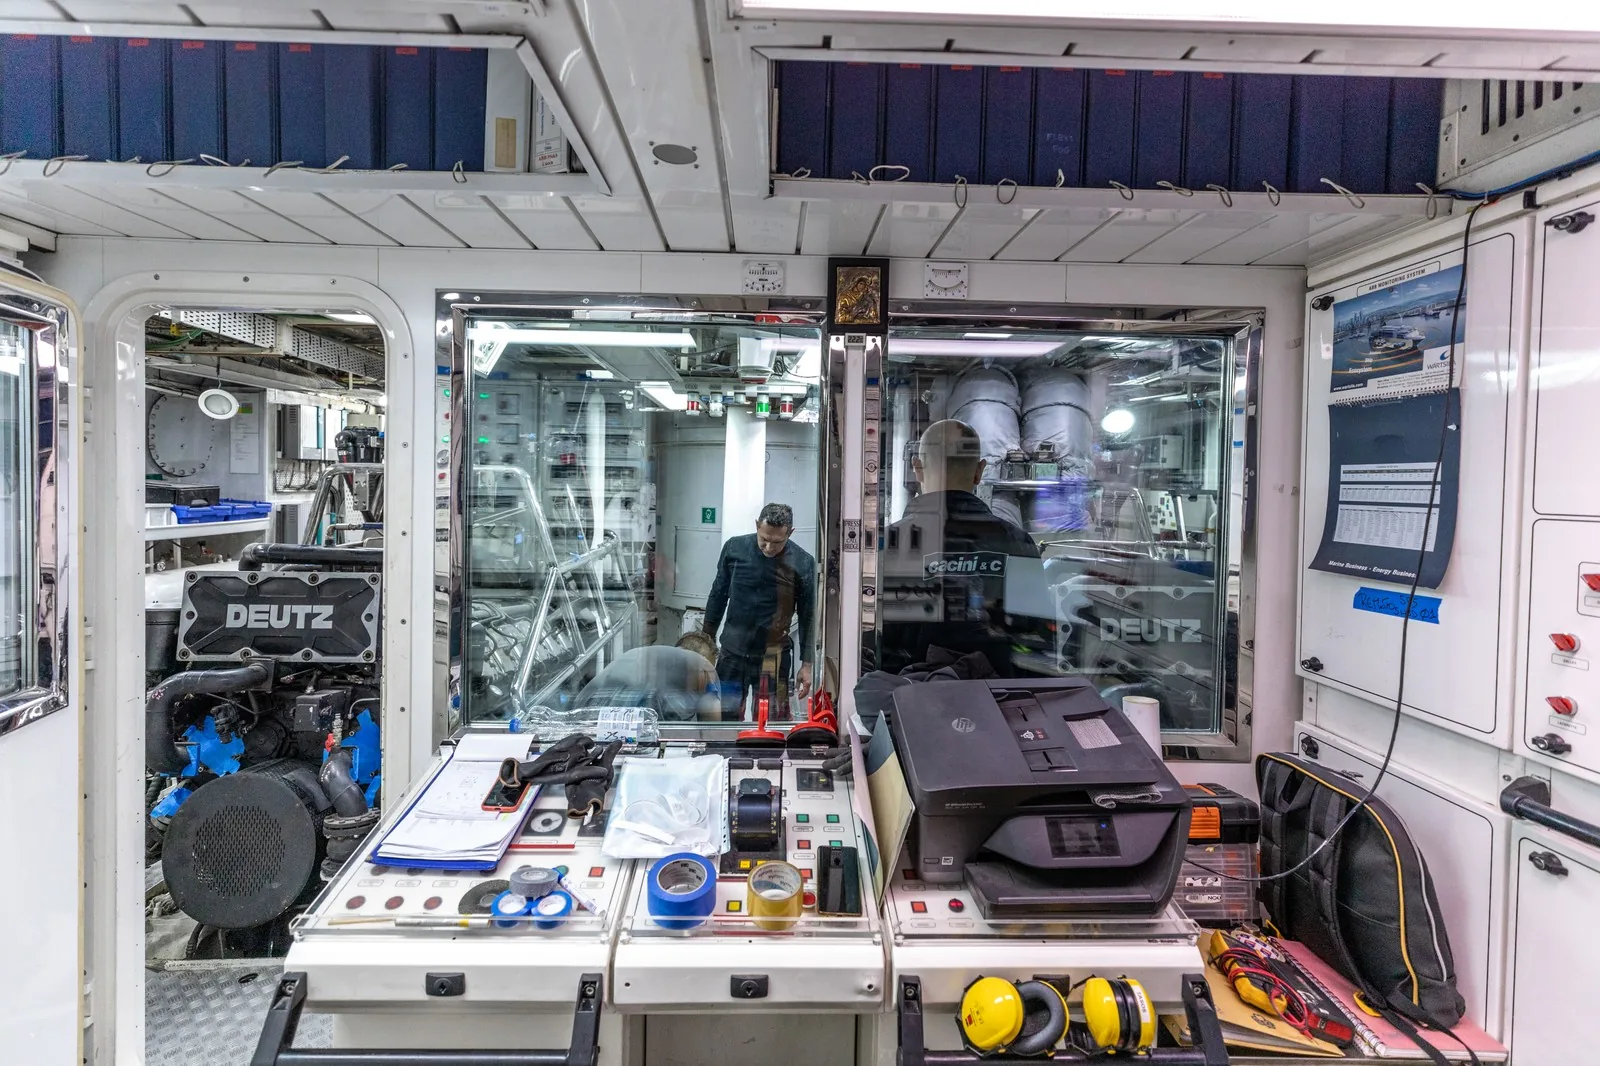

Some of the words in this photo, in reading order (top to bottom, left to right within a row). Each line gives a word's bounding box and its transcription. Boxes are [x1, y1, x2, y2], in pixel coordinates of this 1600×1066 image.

[1378, 275, 1405, 288] MONITORING
[1406, 268, 1426, 280] SYSTEM
[980, 561, 987, 570] &
[1344, 562, 1368, 571] Business
[1372, 566, 1392, 576] Energy
[225, 603, 335, 630] DEUTZ
[1099, 617, 1203, 643] DEUTZ
